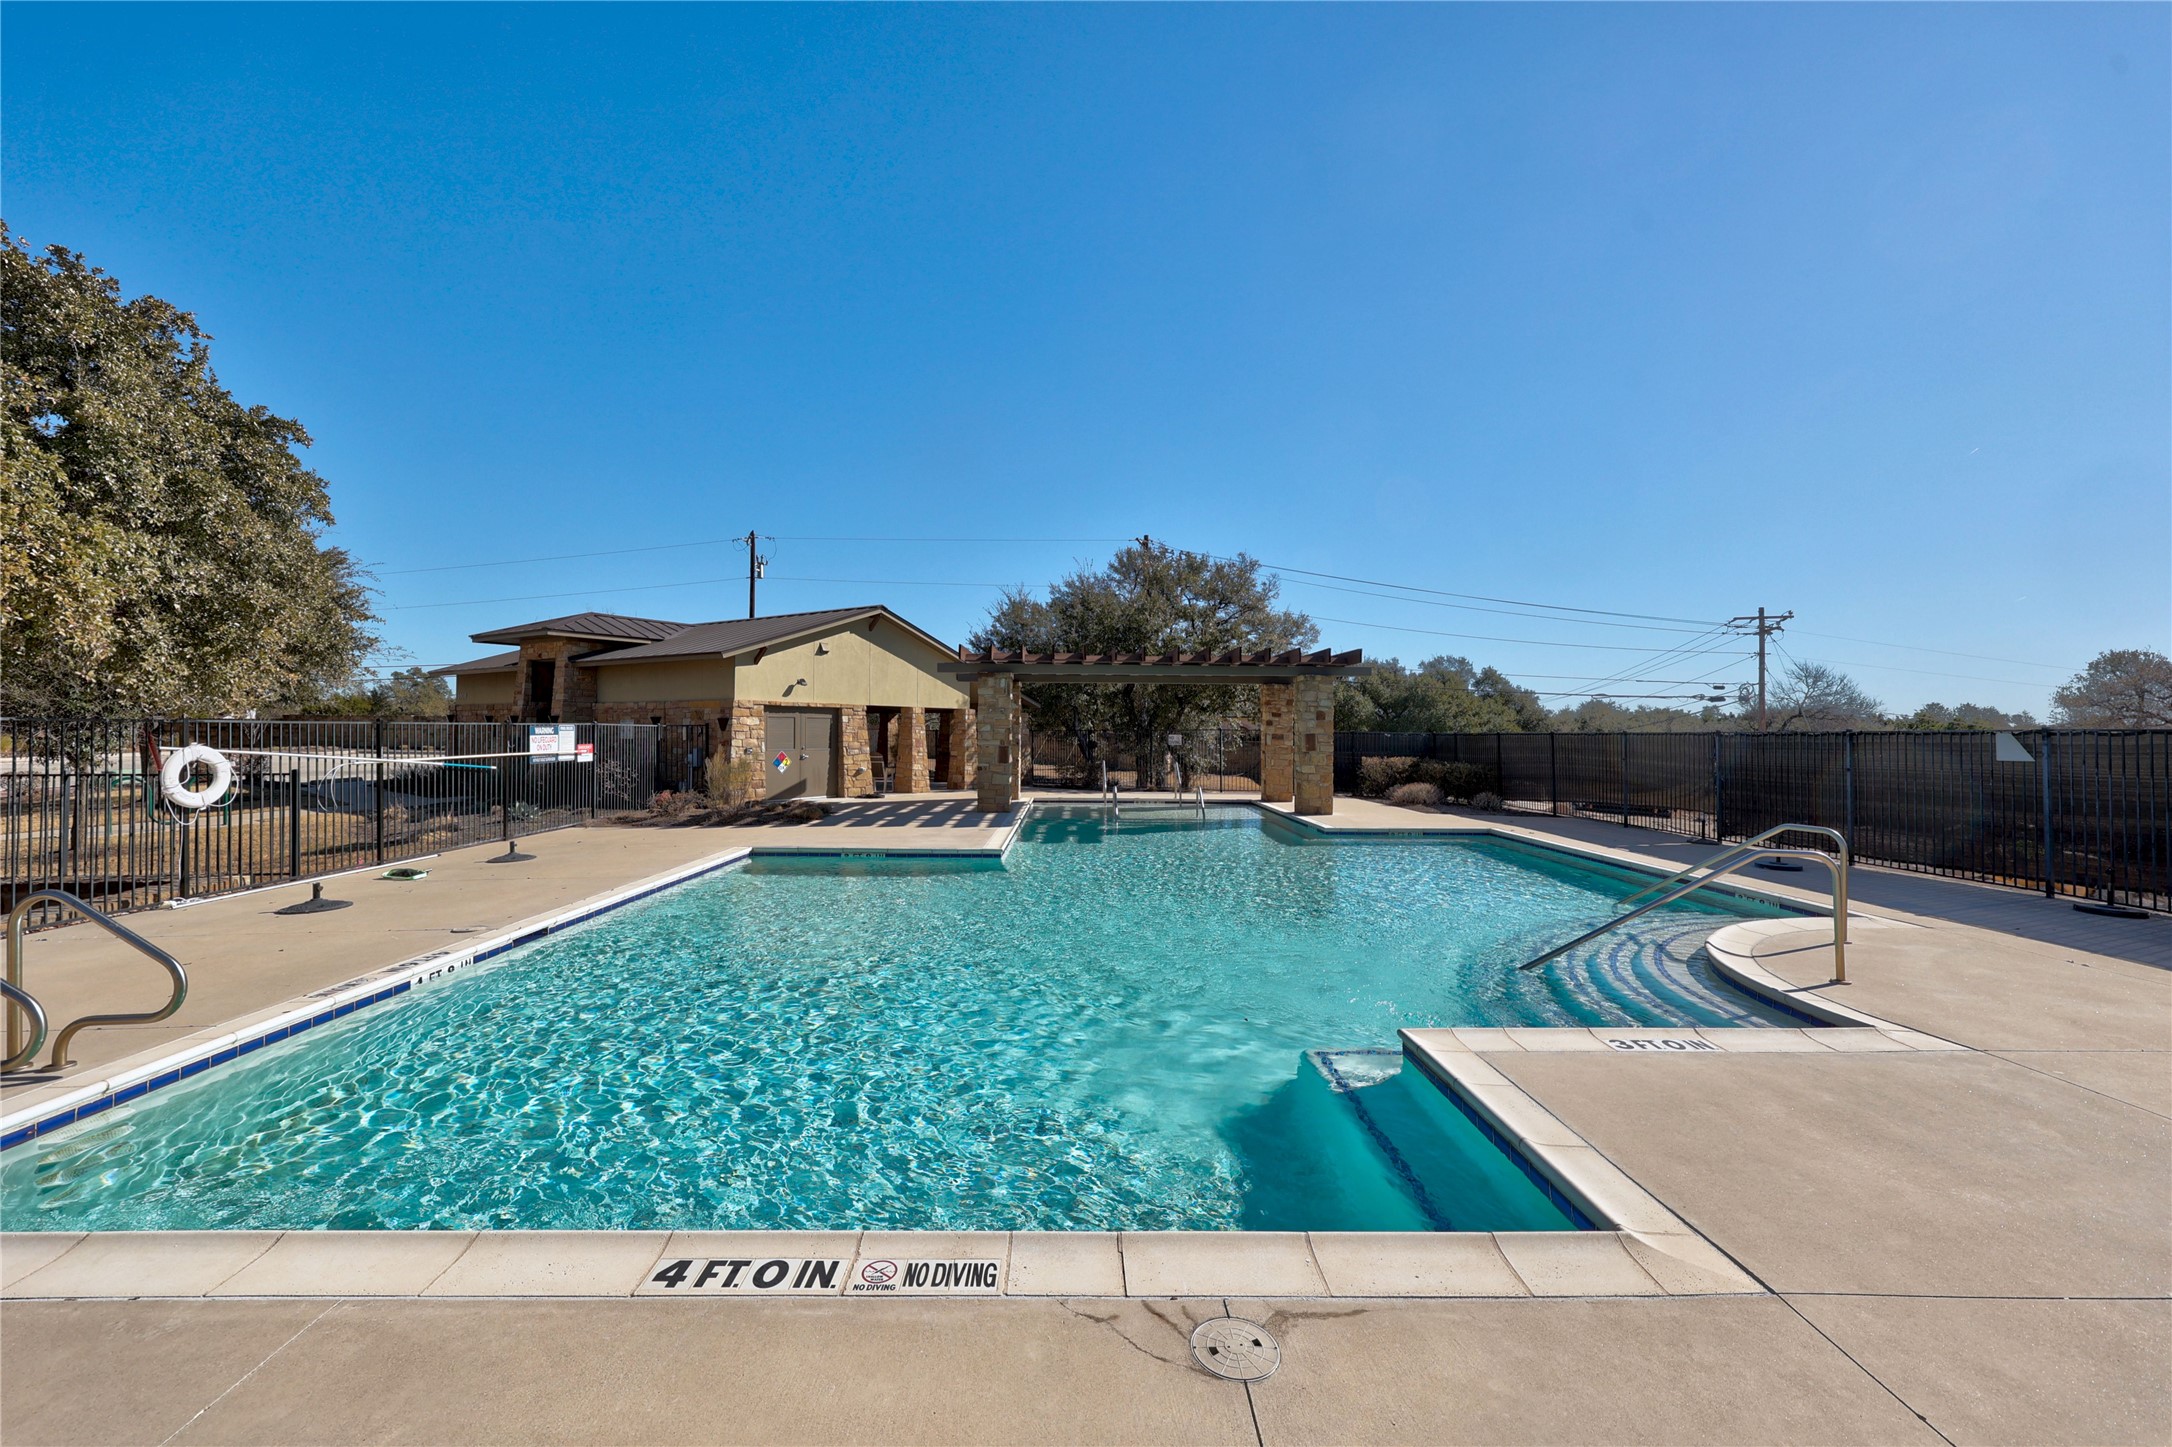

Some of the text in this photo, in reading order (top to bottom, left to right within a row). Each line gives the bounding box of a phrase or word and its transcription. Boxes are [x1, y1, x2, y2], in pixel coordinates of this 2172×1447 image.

[1609, 1039, 1634, 1050] 3
[652, 1260, 694, 1289] 4
[792, 1260, 841, 1289] IN.
[902, 1262, 997, 1288] NO DIVING
